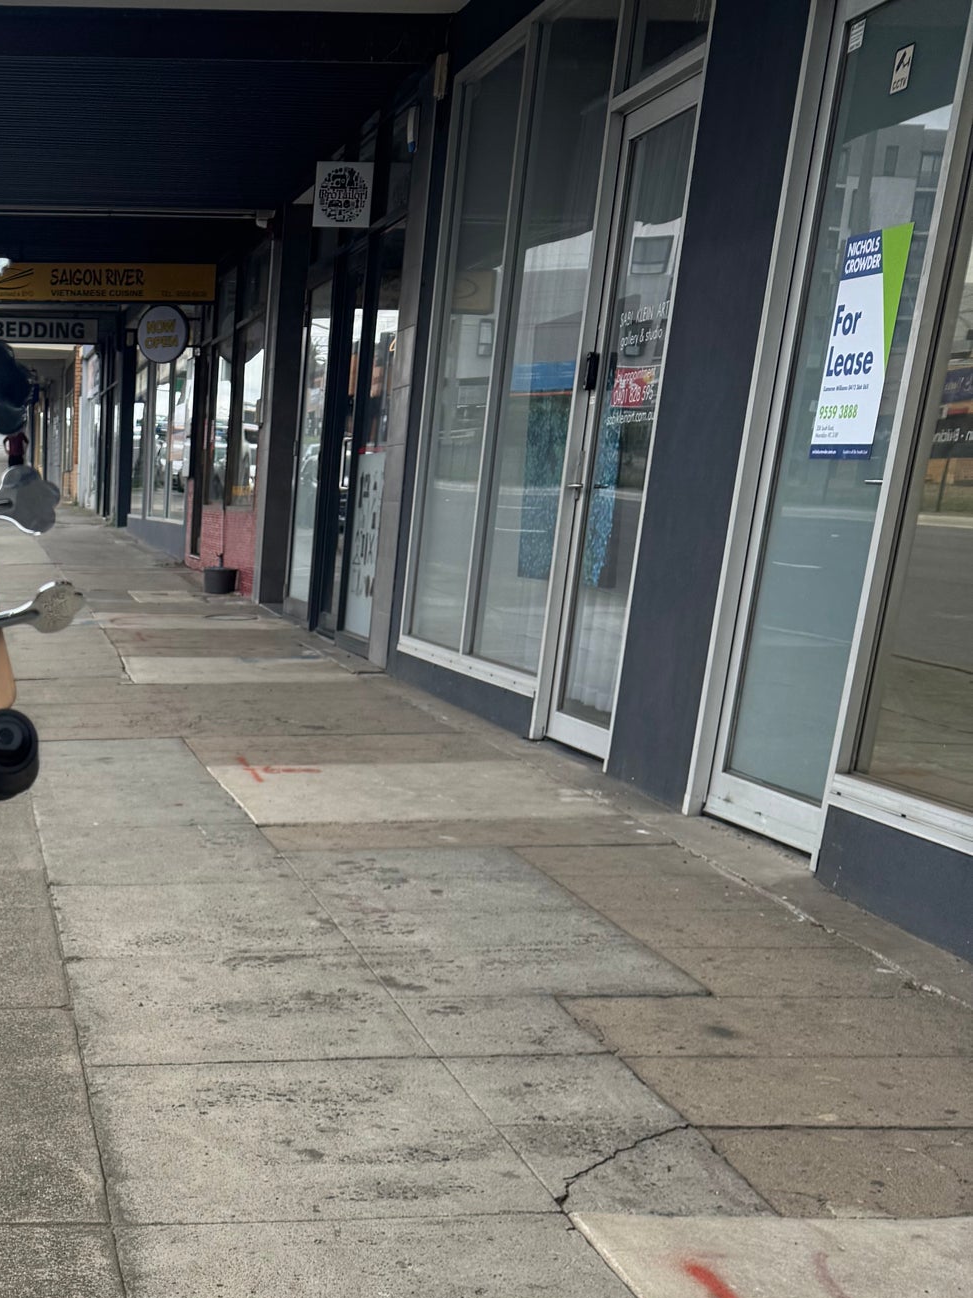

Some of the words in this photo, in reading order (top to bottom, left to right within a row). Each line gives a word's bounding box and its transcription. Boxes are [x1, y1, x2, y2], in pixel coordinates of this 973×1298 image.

[892, 77, 907, 91] CCTV
[847, 236, 880, 256] NICHOLS
[845, 254, 882, 273] CROWDER
[50, 268, 103, 286] SAIGON
[106, 268, 145, 286] RIVER
[636, 305, 654, 322] KLEIN
[657, 300, 670, 318] ART
[833, 304, 862, 337] For
[146, 319, 176, 334] NOW
[144, 335, 179, 350] OPEN
[620, 330, 638, 351] gallery
[645, 325, 663, 342] studio
[826, 346, 874, 377] Lease
[624, 367, 656, 386] appointment
[819, 405, 838, 420] 9559
[839, 404, 858, 419] 3888
